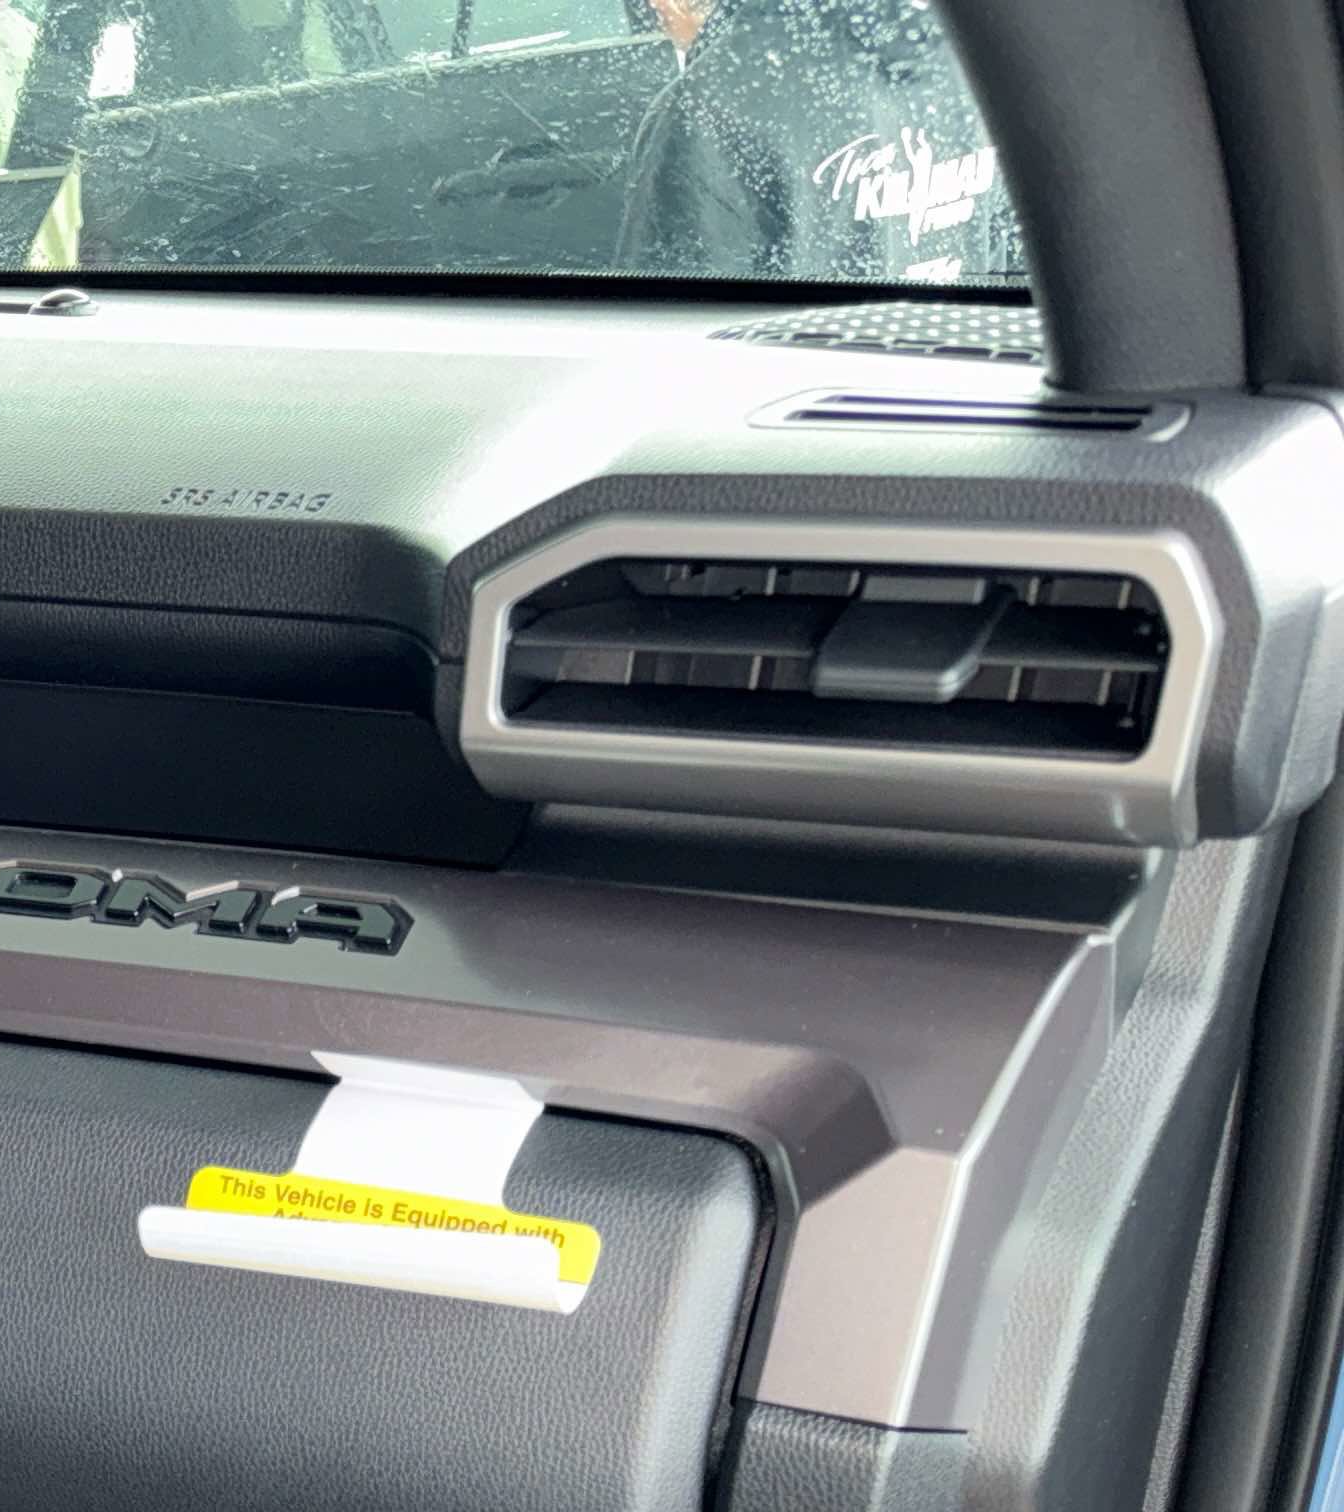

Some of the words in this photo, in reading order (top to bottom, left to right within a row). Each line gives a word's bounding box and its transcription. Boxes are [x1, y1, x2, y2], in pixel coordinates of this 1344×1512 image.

[220, 488, 333, 513] AIRBAG
[220, 1175, 266, 1200] This
[274, 1183, 356, 1214] Vehicle
[364, 1197, 383, 1219] is
[391, 1202, 508, 1236] Equipped
